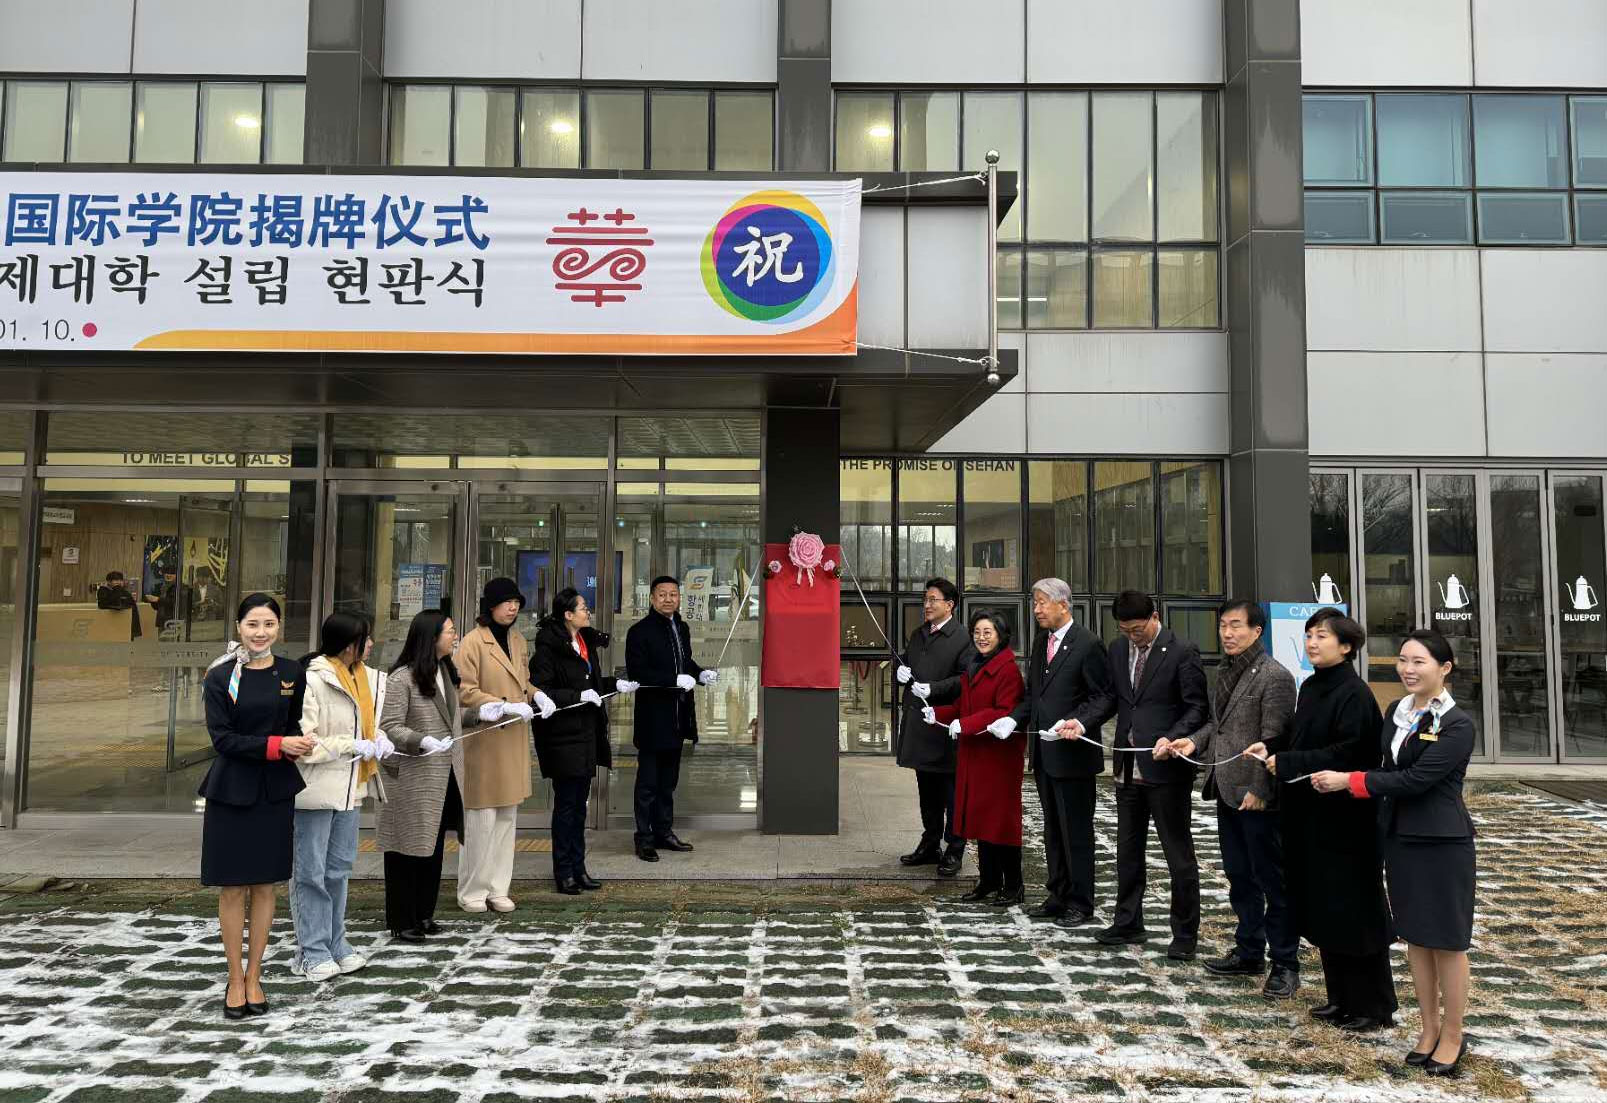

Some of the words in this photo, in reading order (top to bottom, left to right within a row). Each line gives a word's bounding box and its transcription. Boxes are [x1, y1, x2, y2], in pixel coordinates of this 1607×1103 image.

[5, 191, 489, 250] 国际学院揭牌仪式
[732, 226, 804, 286] 祝
[0, 254, 159, 305] 제대학
[184, 255, 289, 305] 설립
[322, 257, 486, 308] 현판식
[41, 319, 74, 342] 10.
[201, 453, 274, 465] GLOAL
[841, 459, 869, 470] THE
[965, 460, 1015, 471] SEHAN
[1435, 612, 1473, 621] BLUEPOT
[1564, 613, 1601, 622] BLUEPOT
